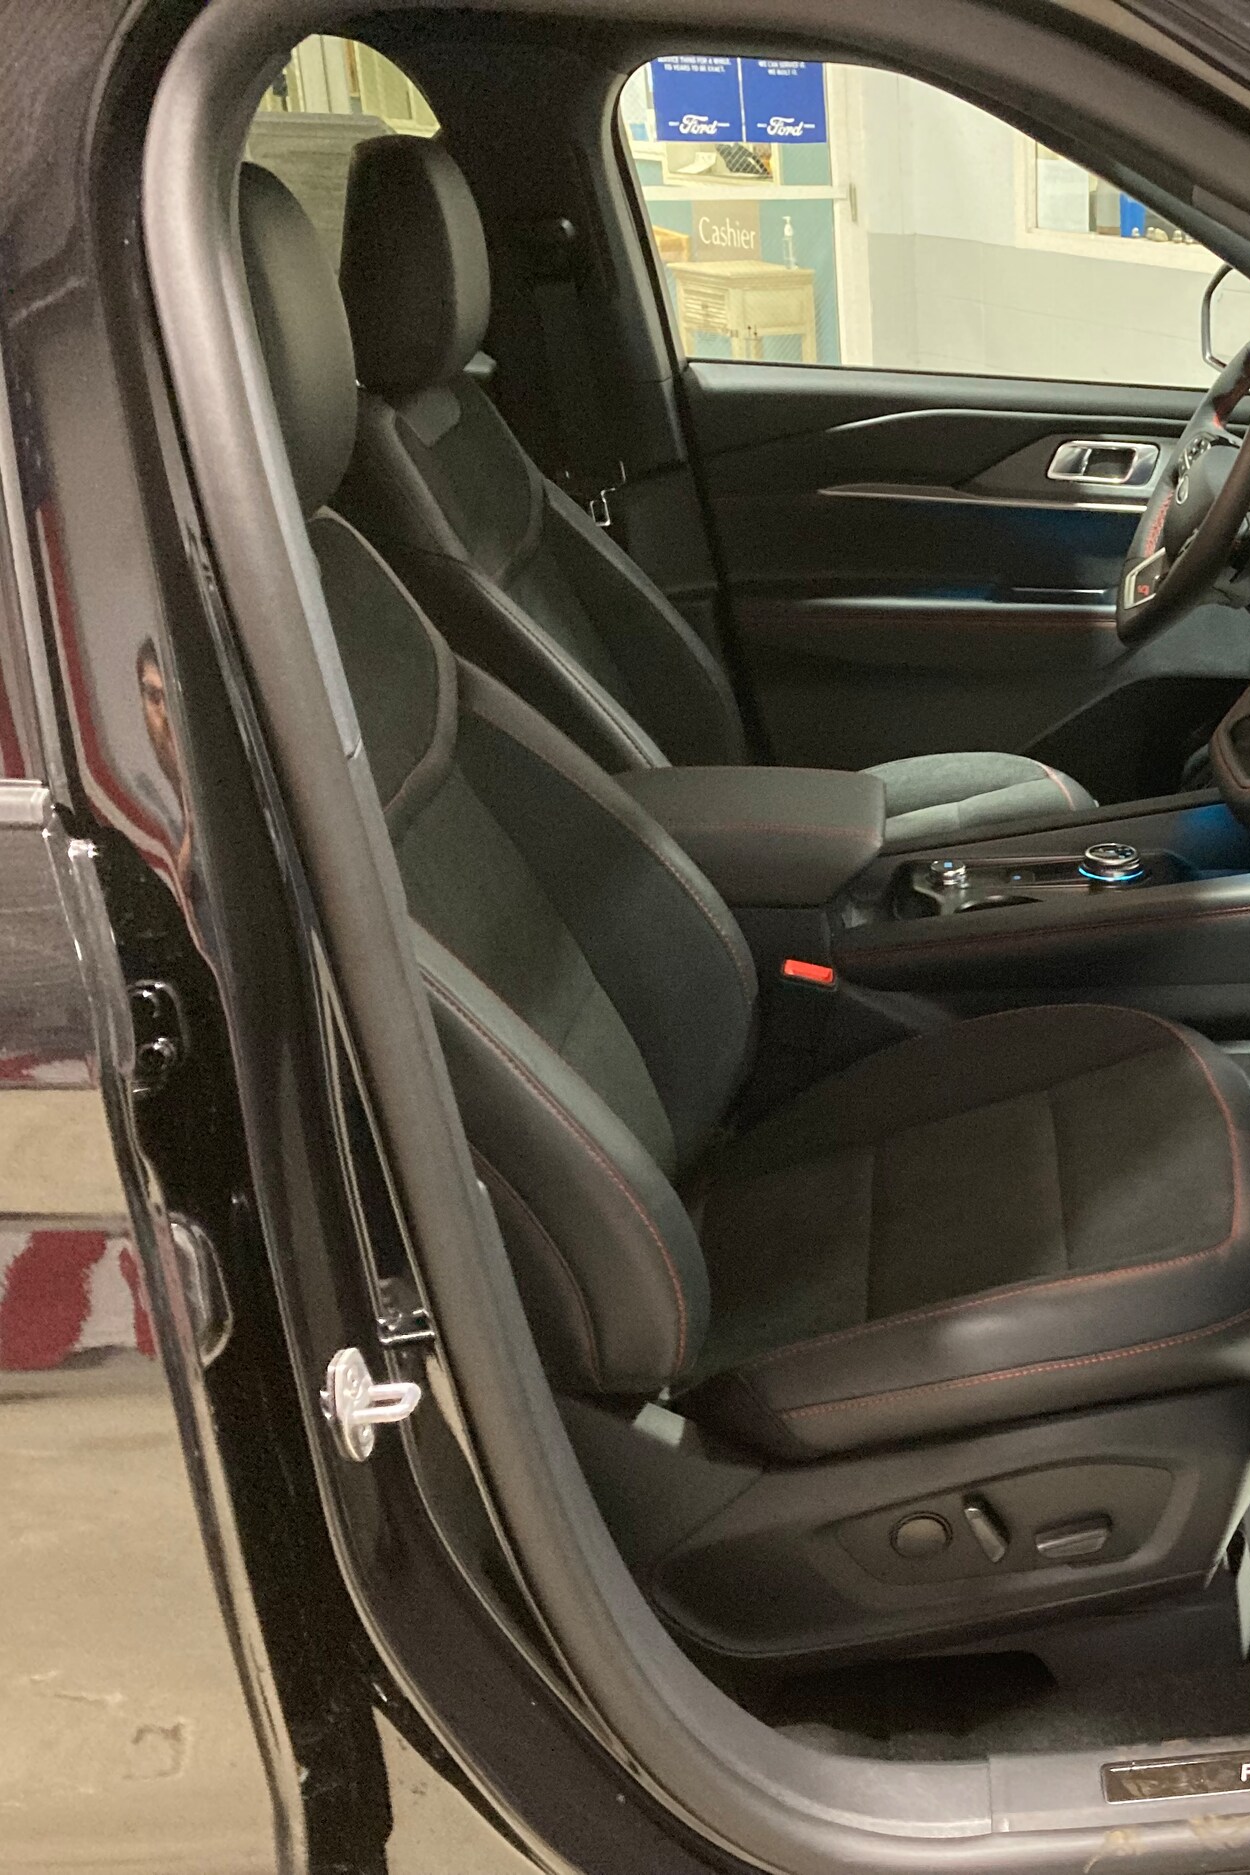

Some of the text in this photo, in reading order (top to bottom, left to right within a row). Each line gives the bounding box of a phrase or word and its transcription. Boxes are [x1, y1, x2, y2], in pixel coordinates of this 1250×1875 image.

[679, 114, 719, 135] Ford
[766, 116, 804, 136] Ford
[699, 216, 756, 249] Cashier
